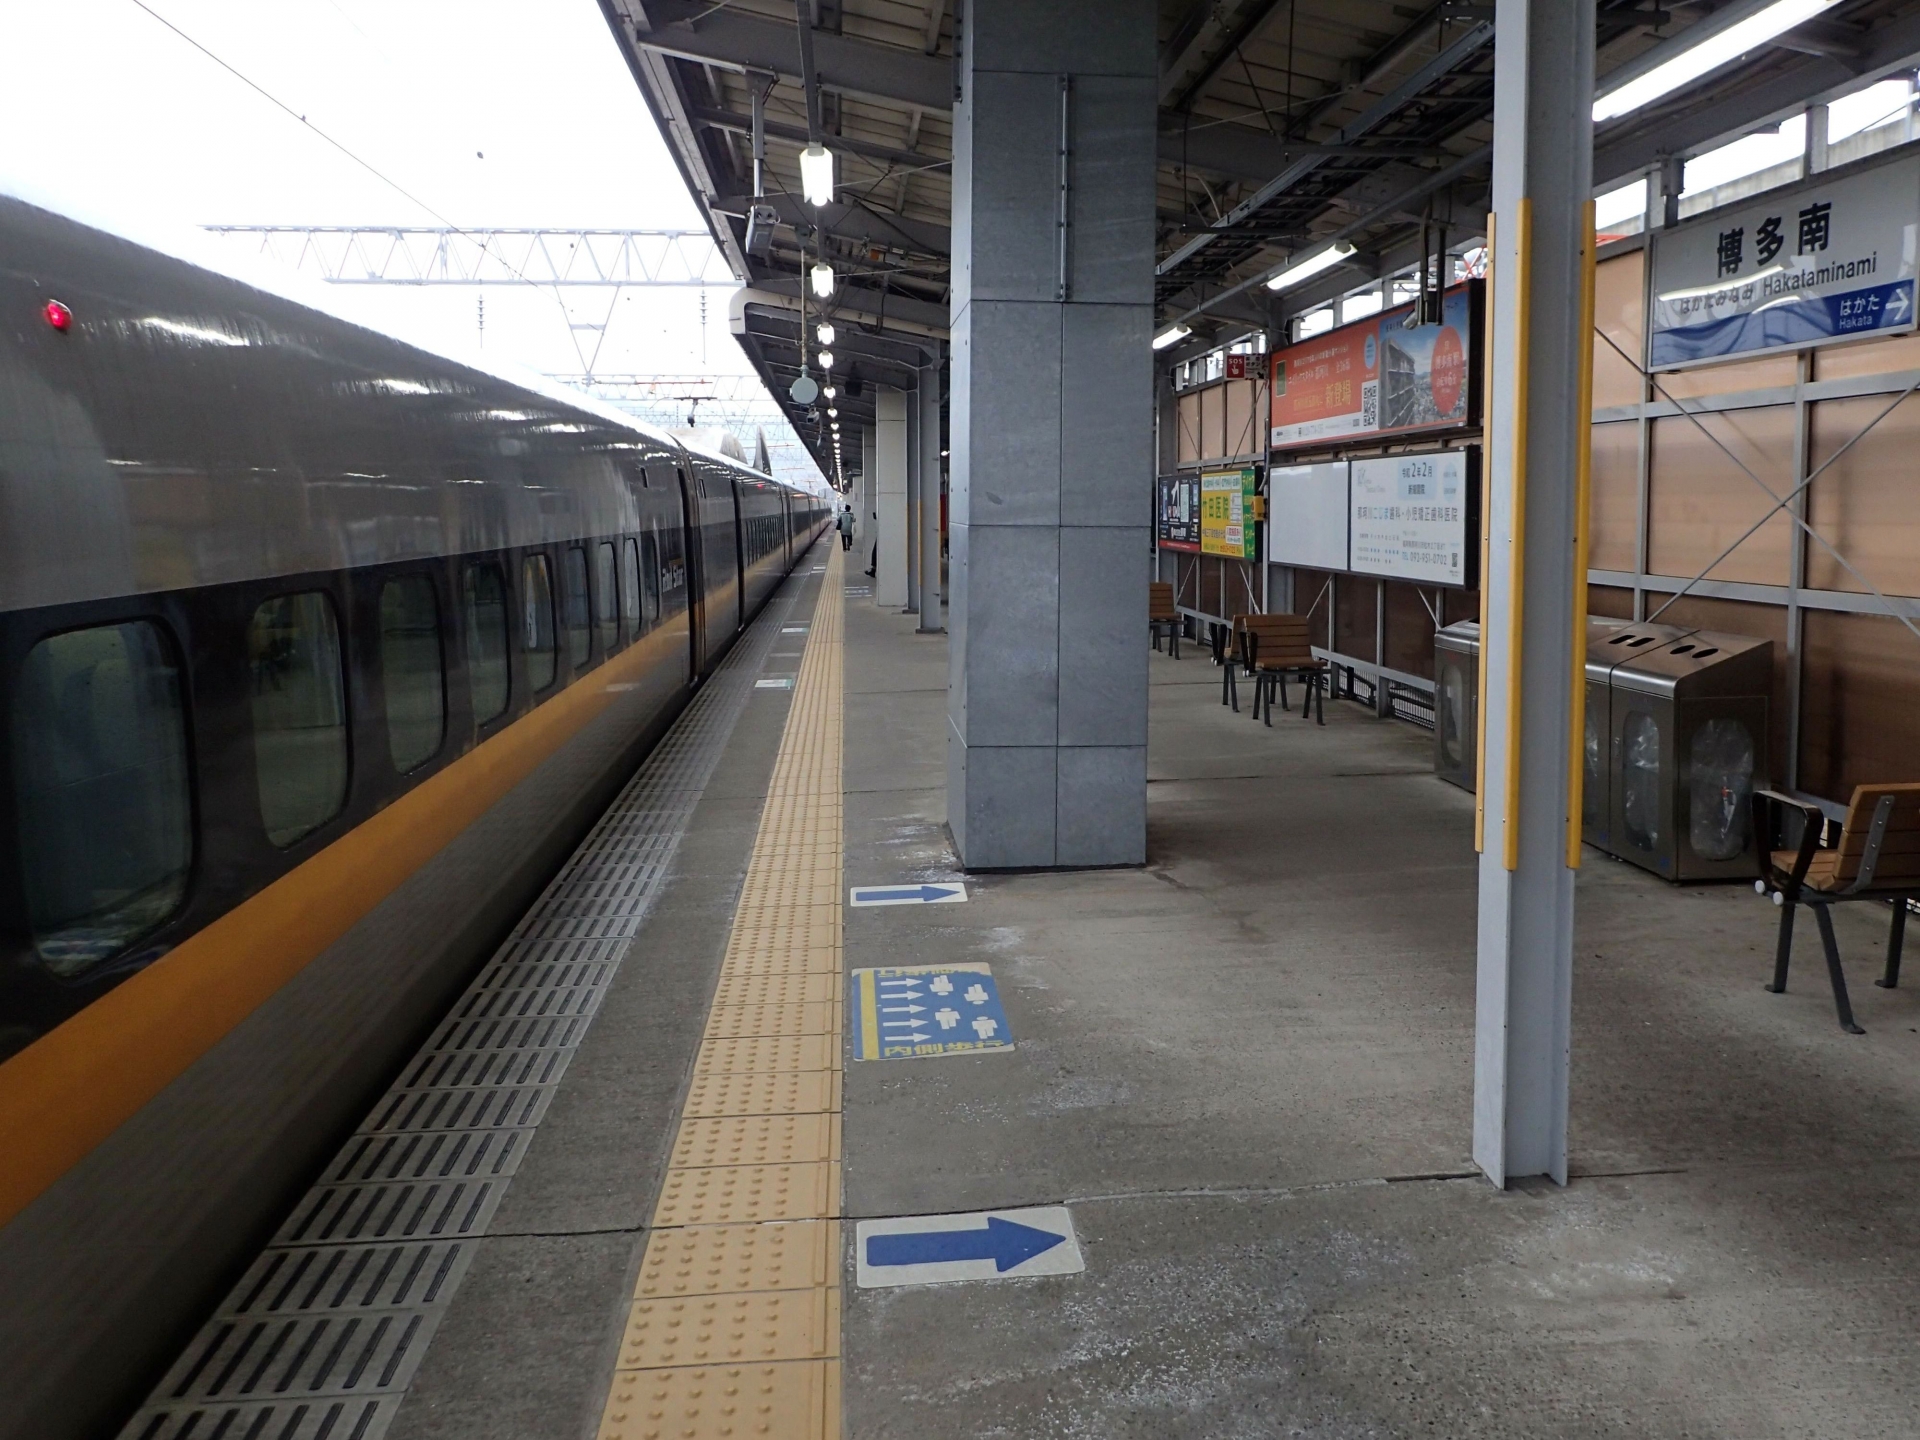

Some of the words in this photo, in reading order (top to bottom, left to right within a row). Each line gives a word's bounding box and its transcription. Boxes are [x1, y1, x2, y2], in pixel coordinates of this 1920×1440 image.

[1716, 202, 1832, 278] 博多南
[1763, 251, 1877, 297] Hakataminami
[1680, 286, 1754, 316] はかたみなみ
[1840, 294, 1880, 316] はかた
[1839, 315, 1873, 329] Hakata
[884, 1040, 1005, 1057] 内側歩行
